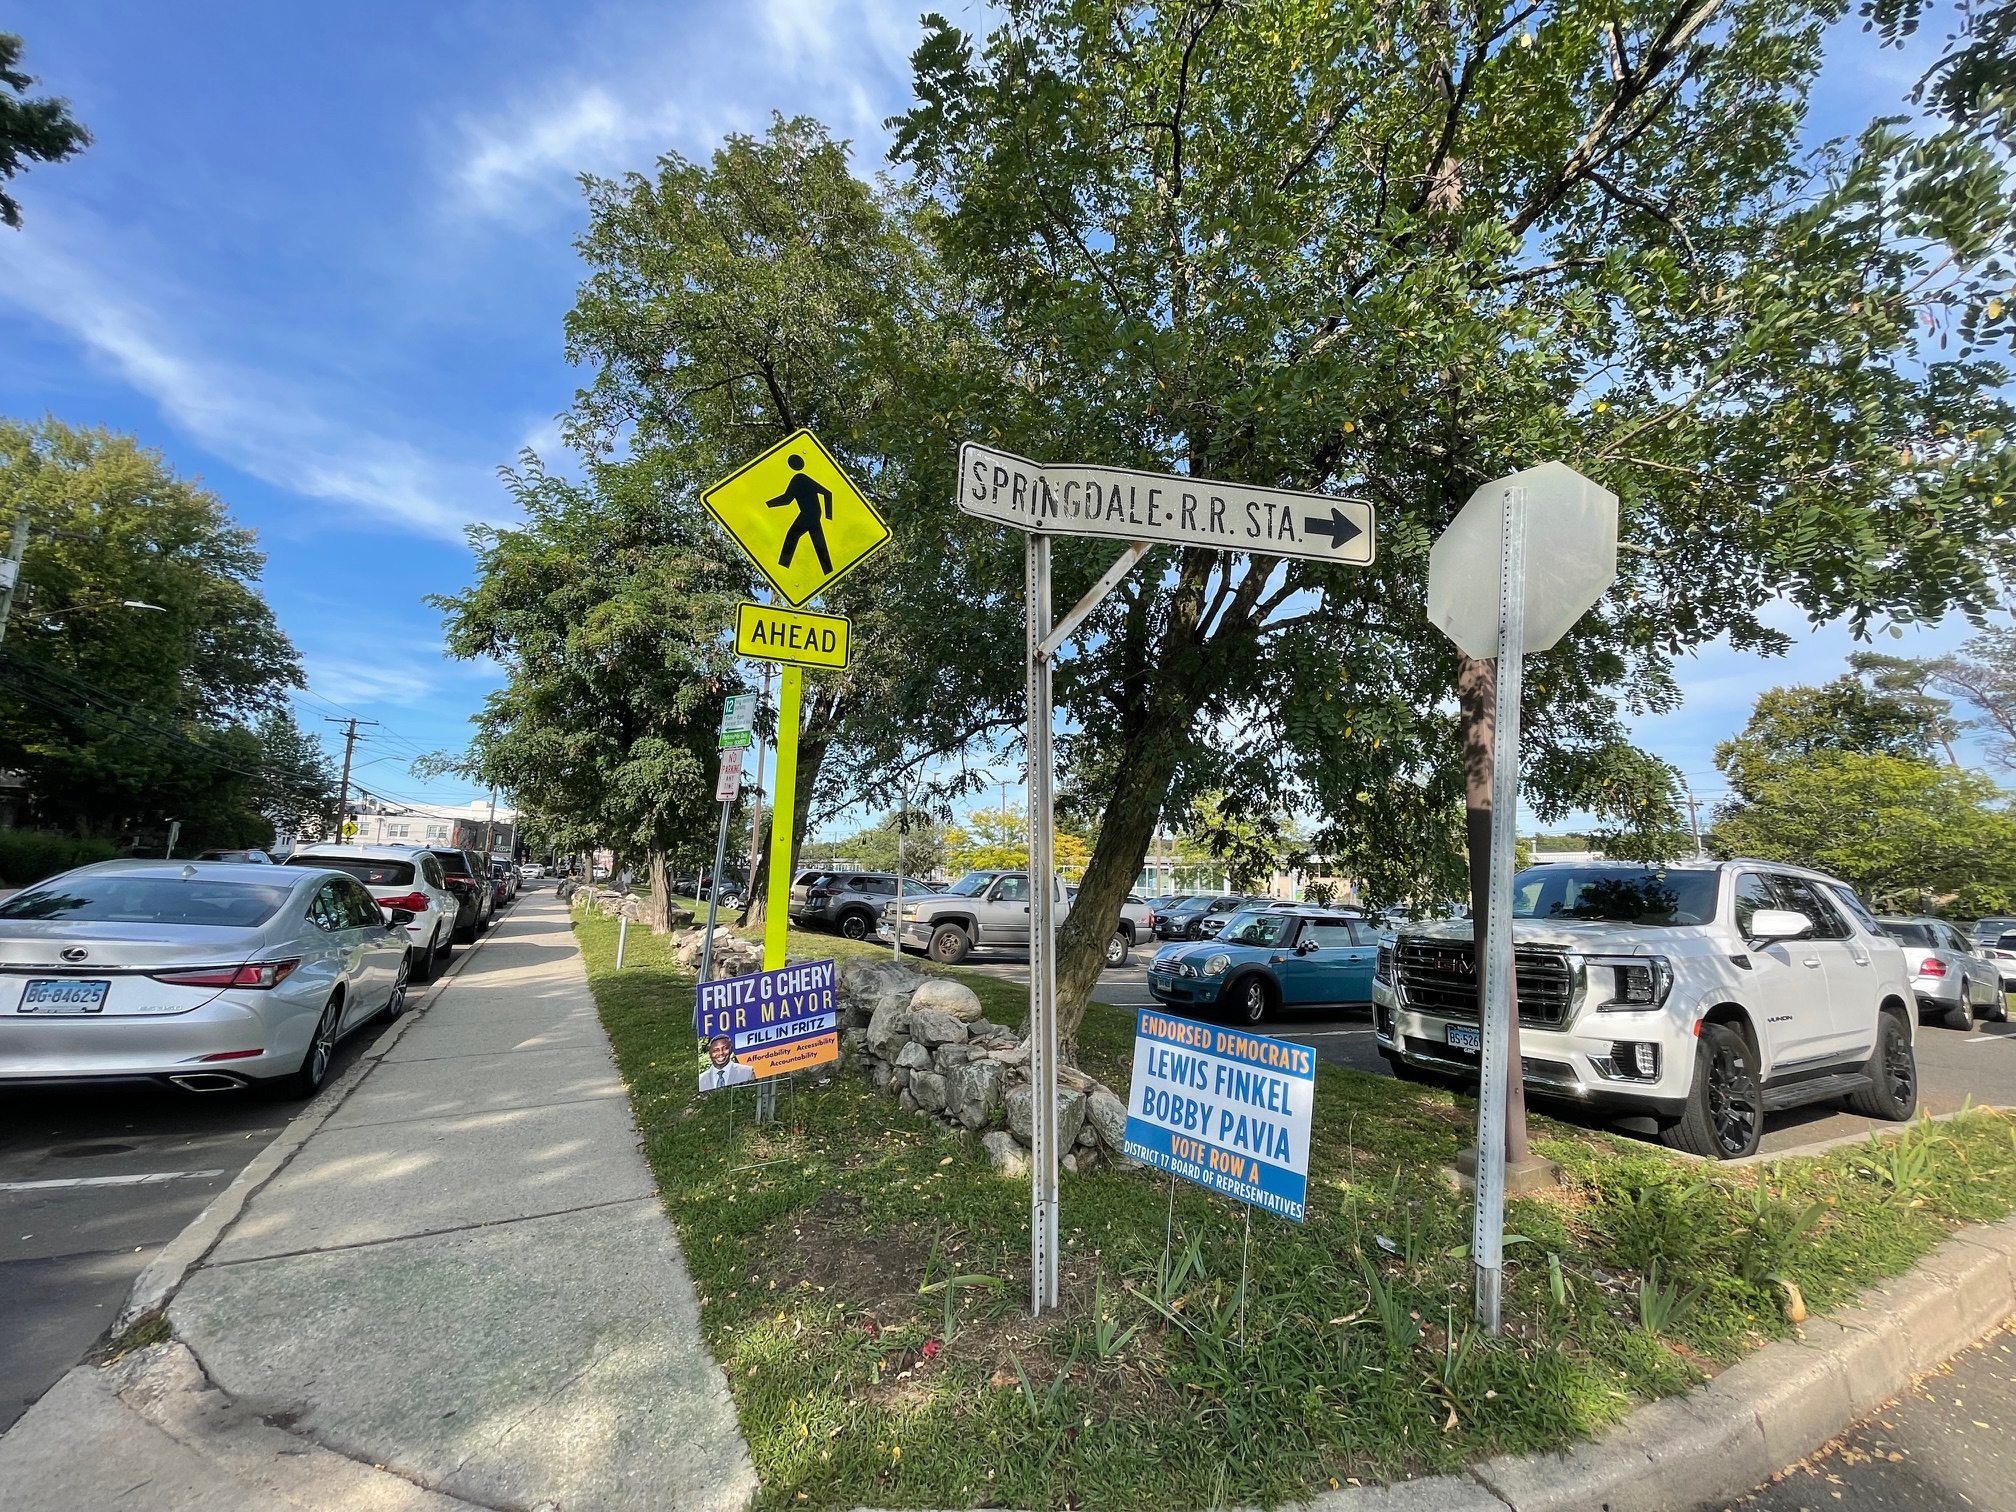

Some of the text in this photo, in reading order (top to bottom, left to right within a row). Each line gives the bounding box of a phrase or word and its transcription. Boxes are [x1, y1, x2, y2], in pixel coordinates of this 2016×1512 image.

[971, 460, 1304, 543] SPRINGDALE R.R. STA.
[751, 619, 836, 653] AHEAD
[721, 764, 741, 774] PARKING
[729, 752, 737, 763] NO
[1434, 956, 1478, 975] GM
[702, 963, 833, 1012] FRITZ G CHERY
[704, 990, 833, 1035] FOR MAYOR
[747, 1017, 825, 1045] FILL IN FRITZ
[746, 1038, 836, 1063] Affordability Accessibility
[769, 1052, 818, 1067] Accountability
[1141, 1014, 1310, 1075] ENDORSED DEMOCRATS
[1450, 1032, 1479, 1048] BS·526
[1147, 1046, 1293, 1117] LEWIS FINKEL
[1142, 1085, 1291, 1164] BOBBY PAVIA
[1124, 1140, 1303, 1219] DISTRICT 17 BOARD OF REPRESENTATIVES
[1171, 1135, 1259, 1185] VOTE ROW A
